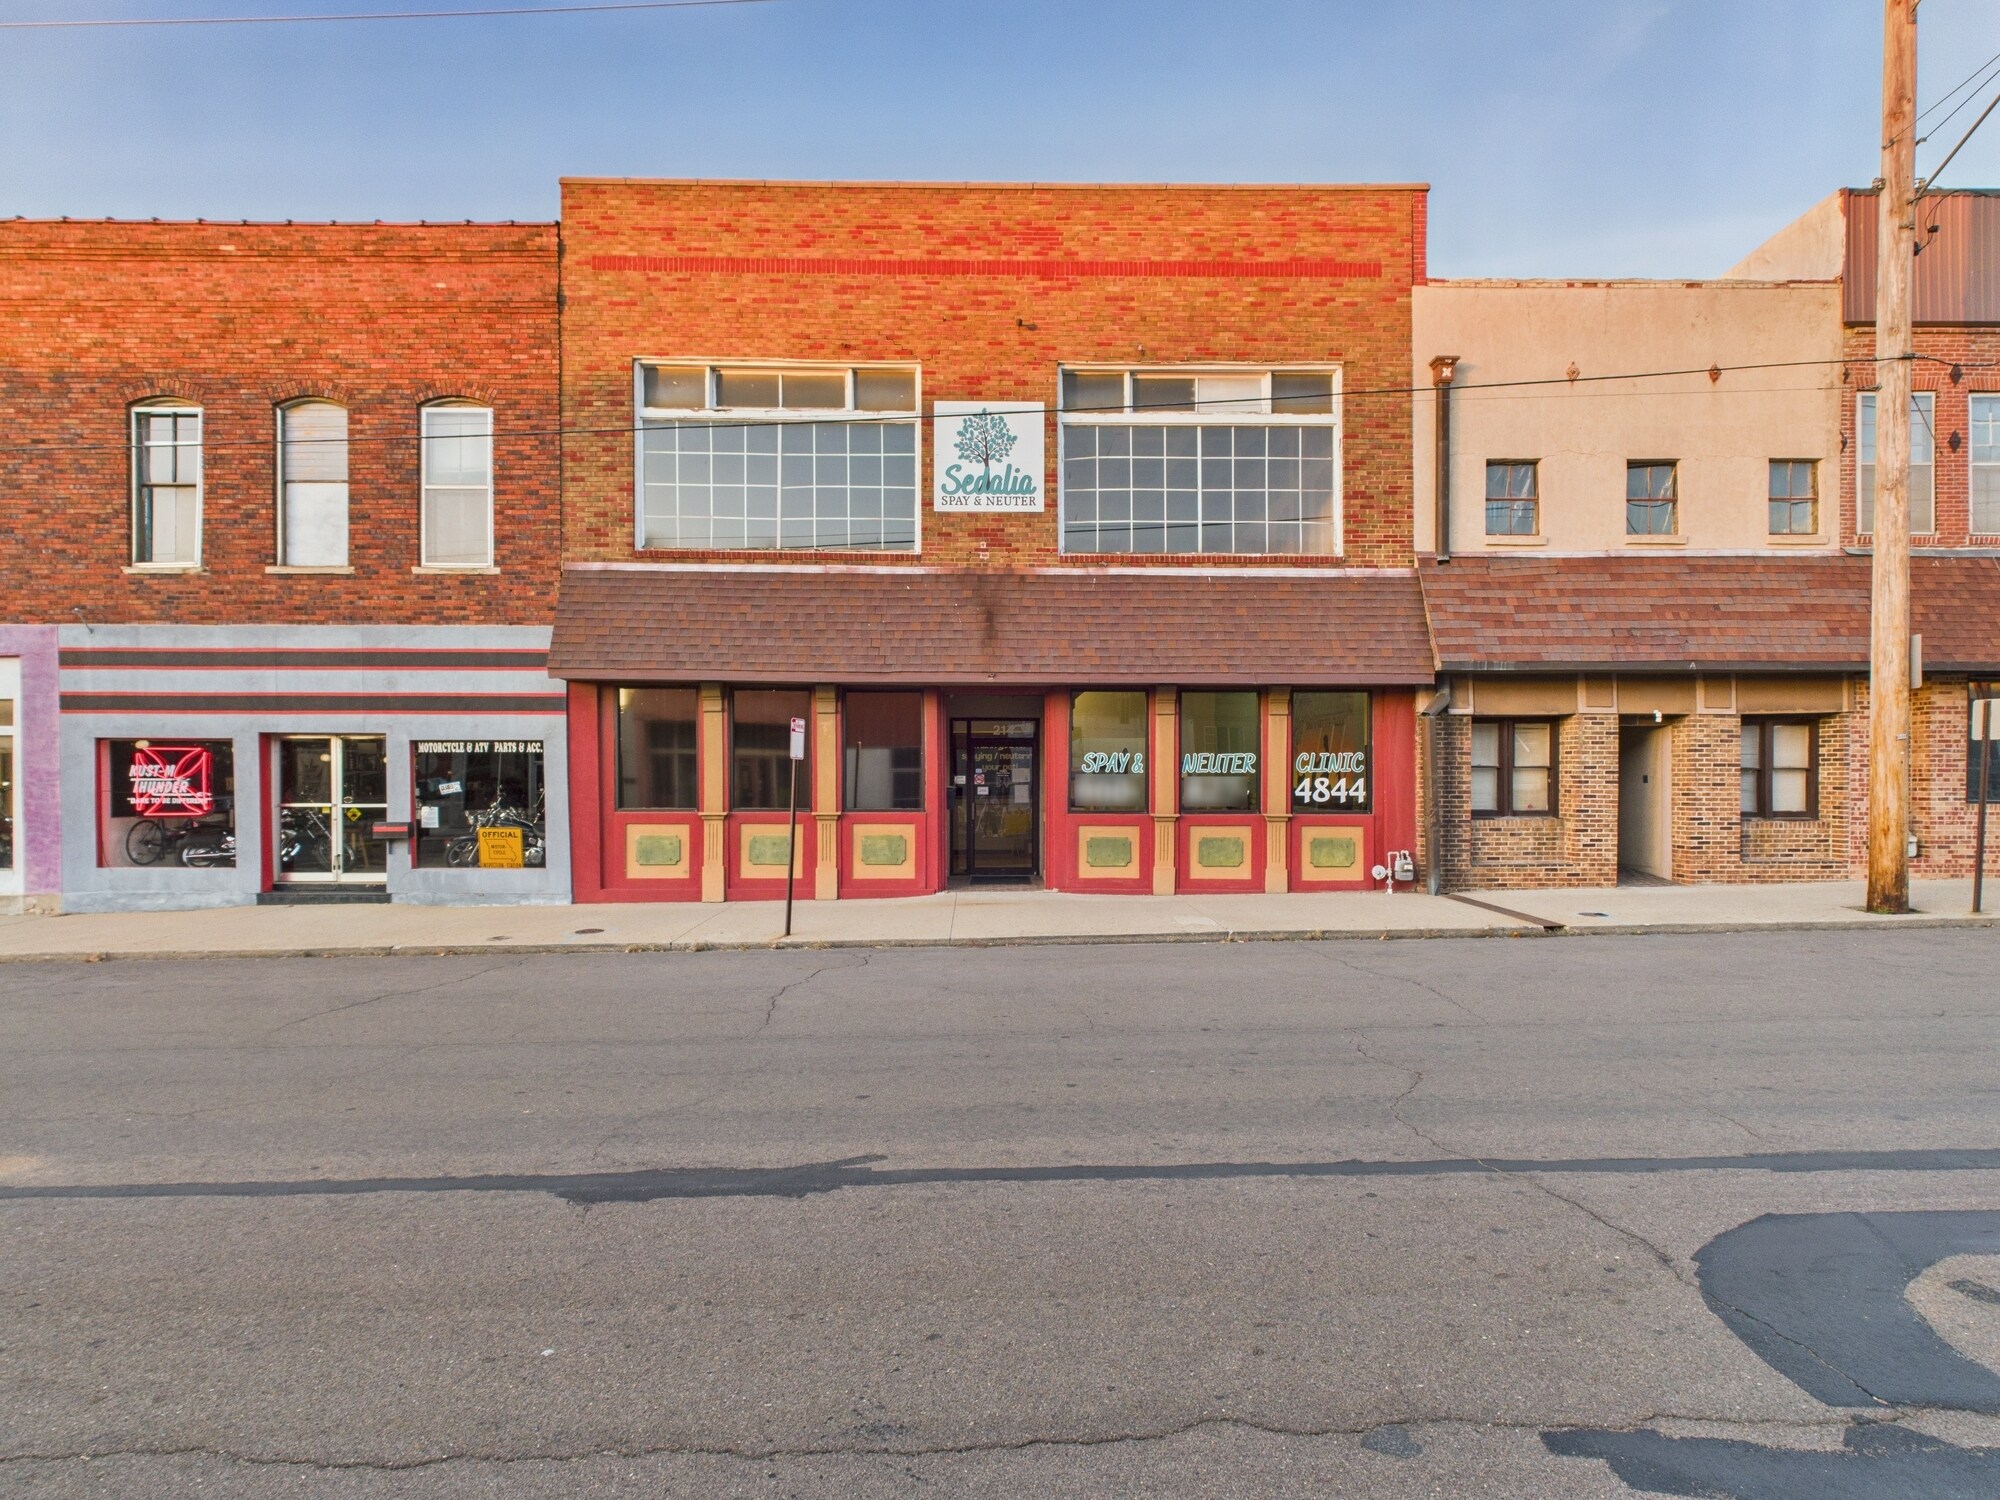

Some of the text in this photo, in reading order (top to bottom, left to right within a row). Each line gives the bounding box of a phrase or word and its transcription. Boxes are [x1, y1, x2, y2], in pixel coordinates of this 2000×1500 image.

[941, 463, 1037, 495] Sedalia
[941, 496, 1037, 506] SPAY & NEUTER
[418, 742, 543, 753] MOTORCYCLE & ATV PARTS & ACC.
[1081, 752, 1365, 774] SPAY & NEUTER CLINIC
[132, 781, 189, 793] THUNDER
[1294, 777, 1367, 804] 4844
